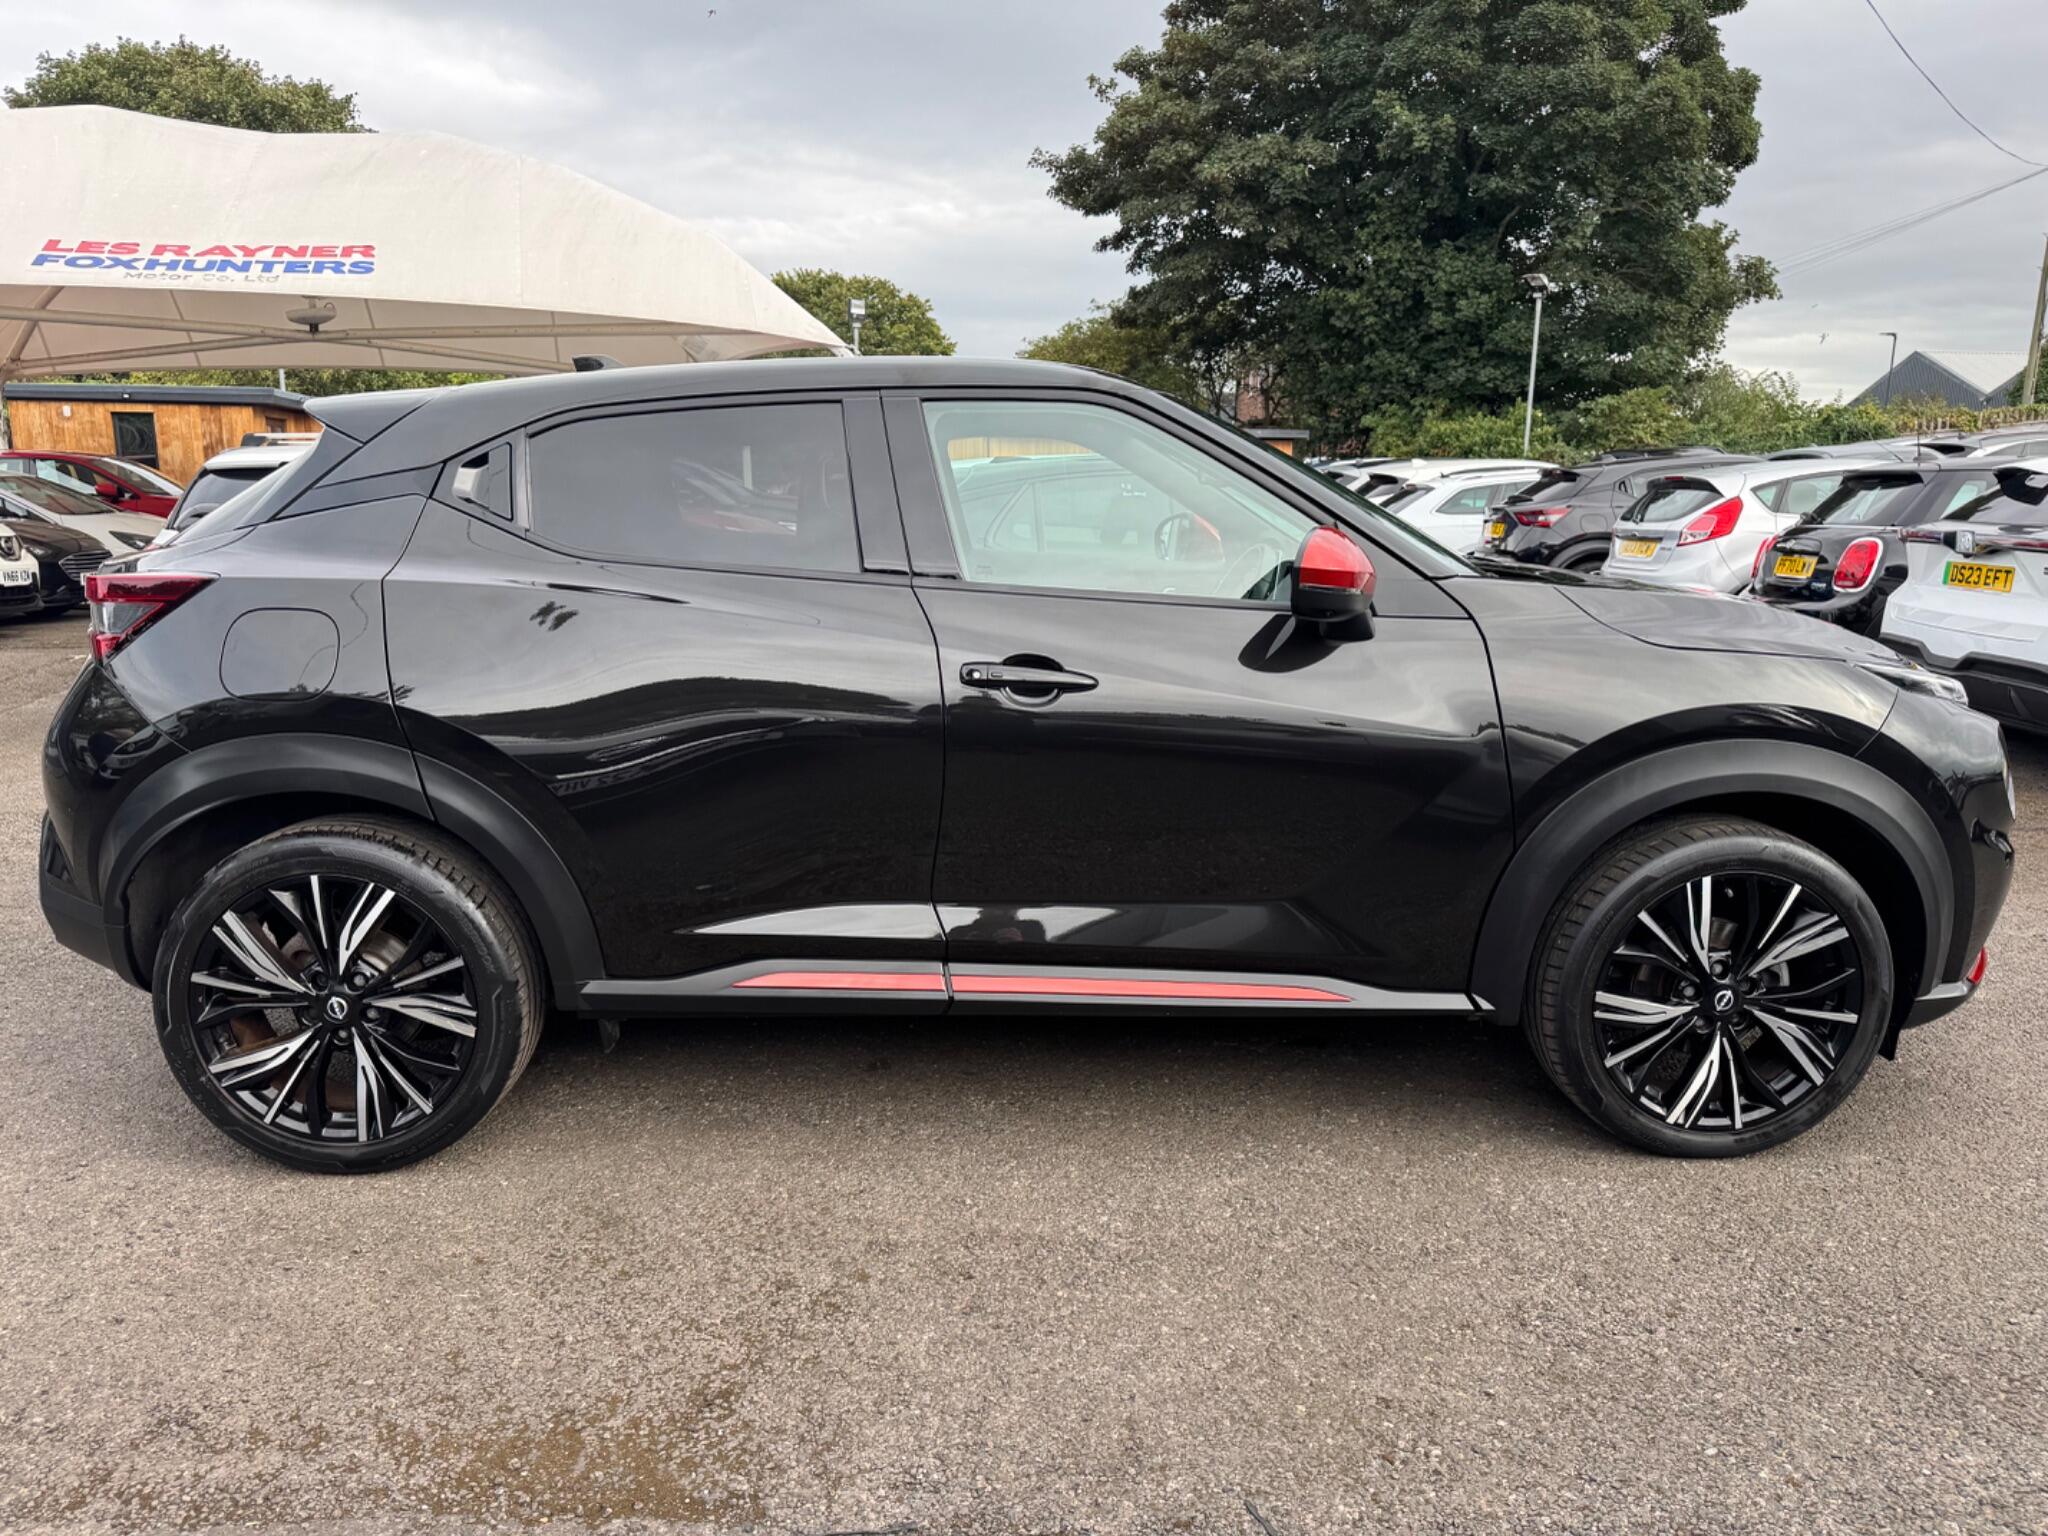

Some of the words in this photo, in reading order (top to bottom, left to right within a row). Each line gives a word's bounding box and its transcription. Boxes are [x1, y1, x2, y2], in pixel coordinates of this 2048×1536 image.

[42, 239, 140, 254] LES
[150, 244, 376, 258] RAYNER
[31, 254, 376, 275] FOXHUNTERS
[122, 272, 191, 281] Motor
[201, 273, 235, 282] Co.
[244, 274, 280, 283] Ltd
[1950, 564, 1982, 585] DS23
[1984, 568, 2012, 588] EFT
